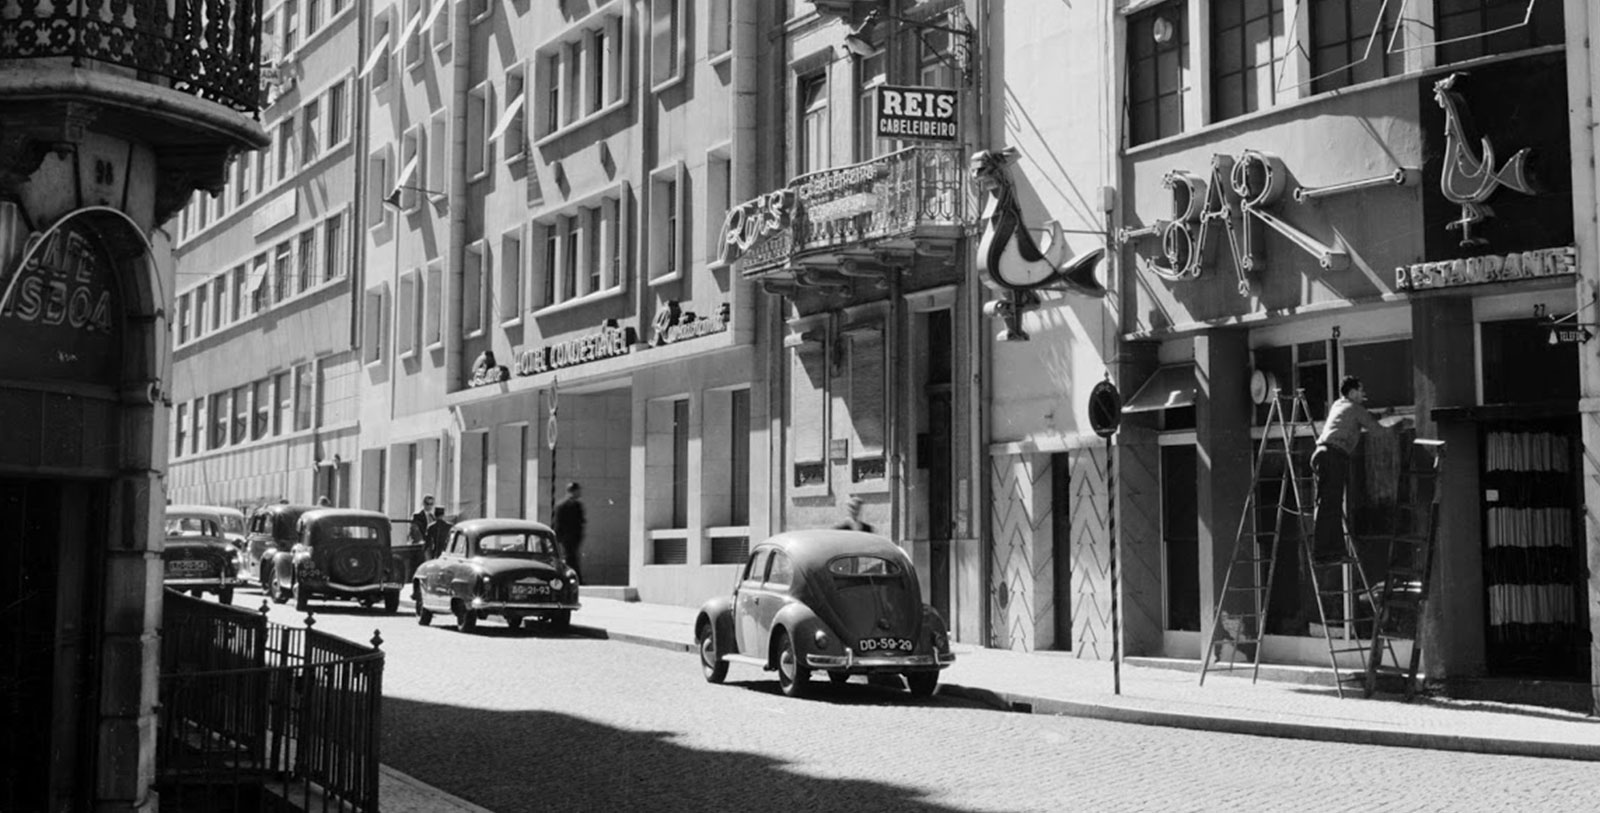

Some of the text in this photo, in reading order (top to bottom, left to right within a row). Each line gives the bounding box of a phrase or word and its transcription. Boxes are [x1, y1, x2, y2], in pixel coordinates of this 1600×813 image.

[882, 90, 955, 118] REIS
[879, 118, 957, 138] CABELEIREIRO
[1145, 148, 1345, 297] BAR
[1395, 246, 1576, 290] RESTAURANTE
[4, 276, 113, 333] ISBOA
[1533, 303, 1546, 318] 27
[514, 345, 547, 374] HOTEL
[859, 637, 913, 651] DD-59-29
